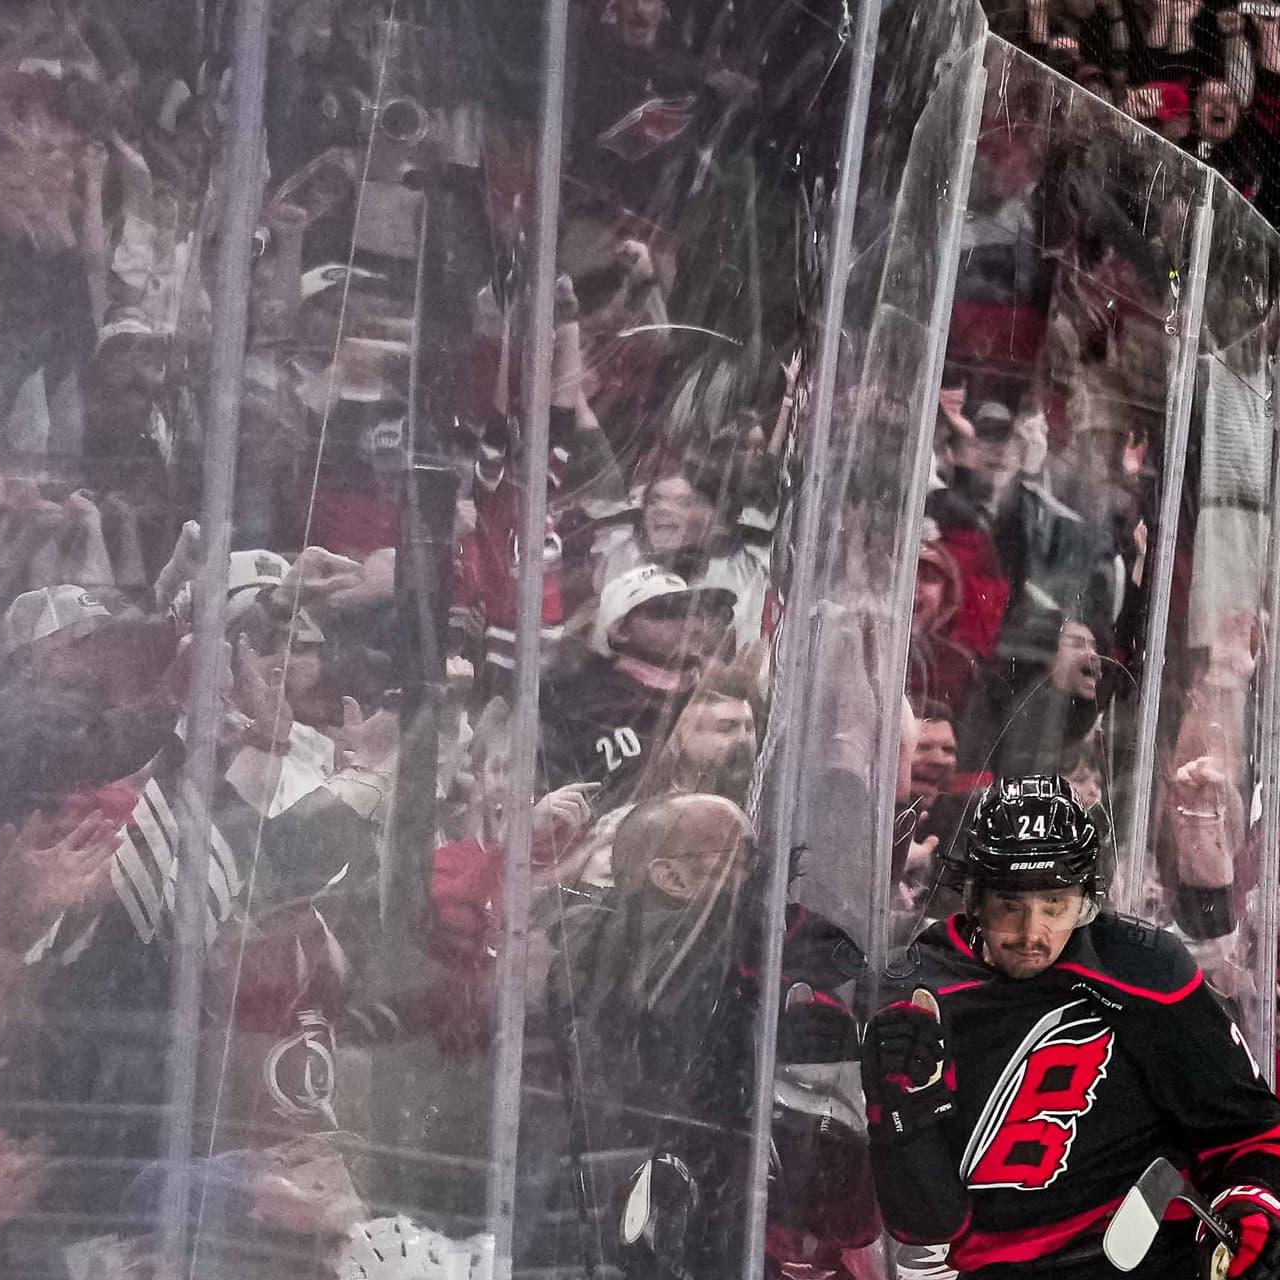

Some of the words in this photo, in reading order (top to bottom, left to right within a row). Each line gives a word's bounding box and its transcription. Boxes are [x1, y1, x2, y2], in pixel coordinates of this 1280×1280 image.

[596, 727, 642, 771] 20
[1018, 815, 1046, 839] 24
[1010, 860, 1055, 871] BAUER
